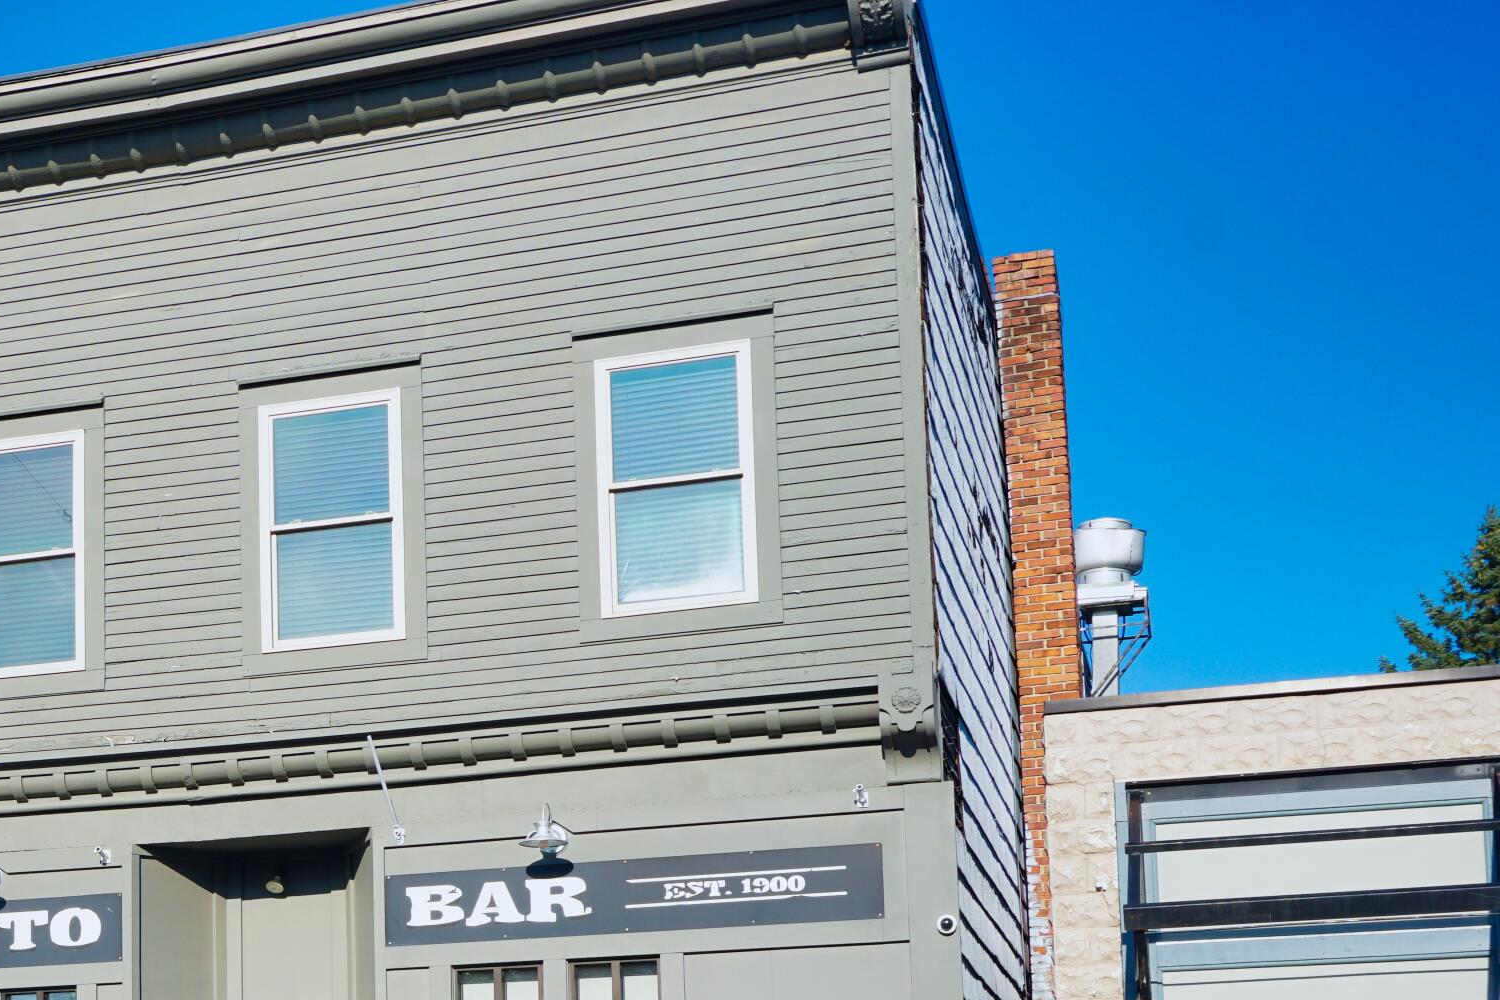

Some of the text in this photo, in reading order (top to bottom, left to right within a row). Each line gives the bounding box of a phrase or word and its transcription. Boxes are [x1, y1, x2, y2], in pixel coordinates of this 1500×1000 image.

[405, 874, 806, 927] BAR EST. 1900
